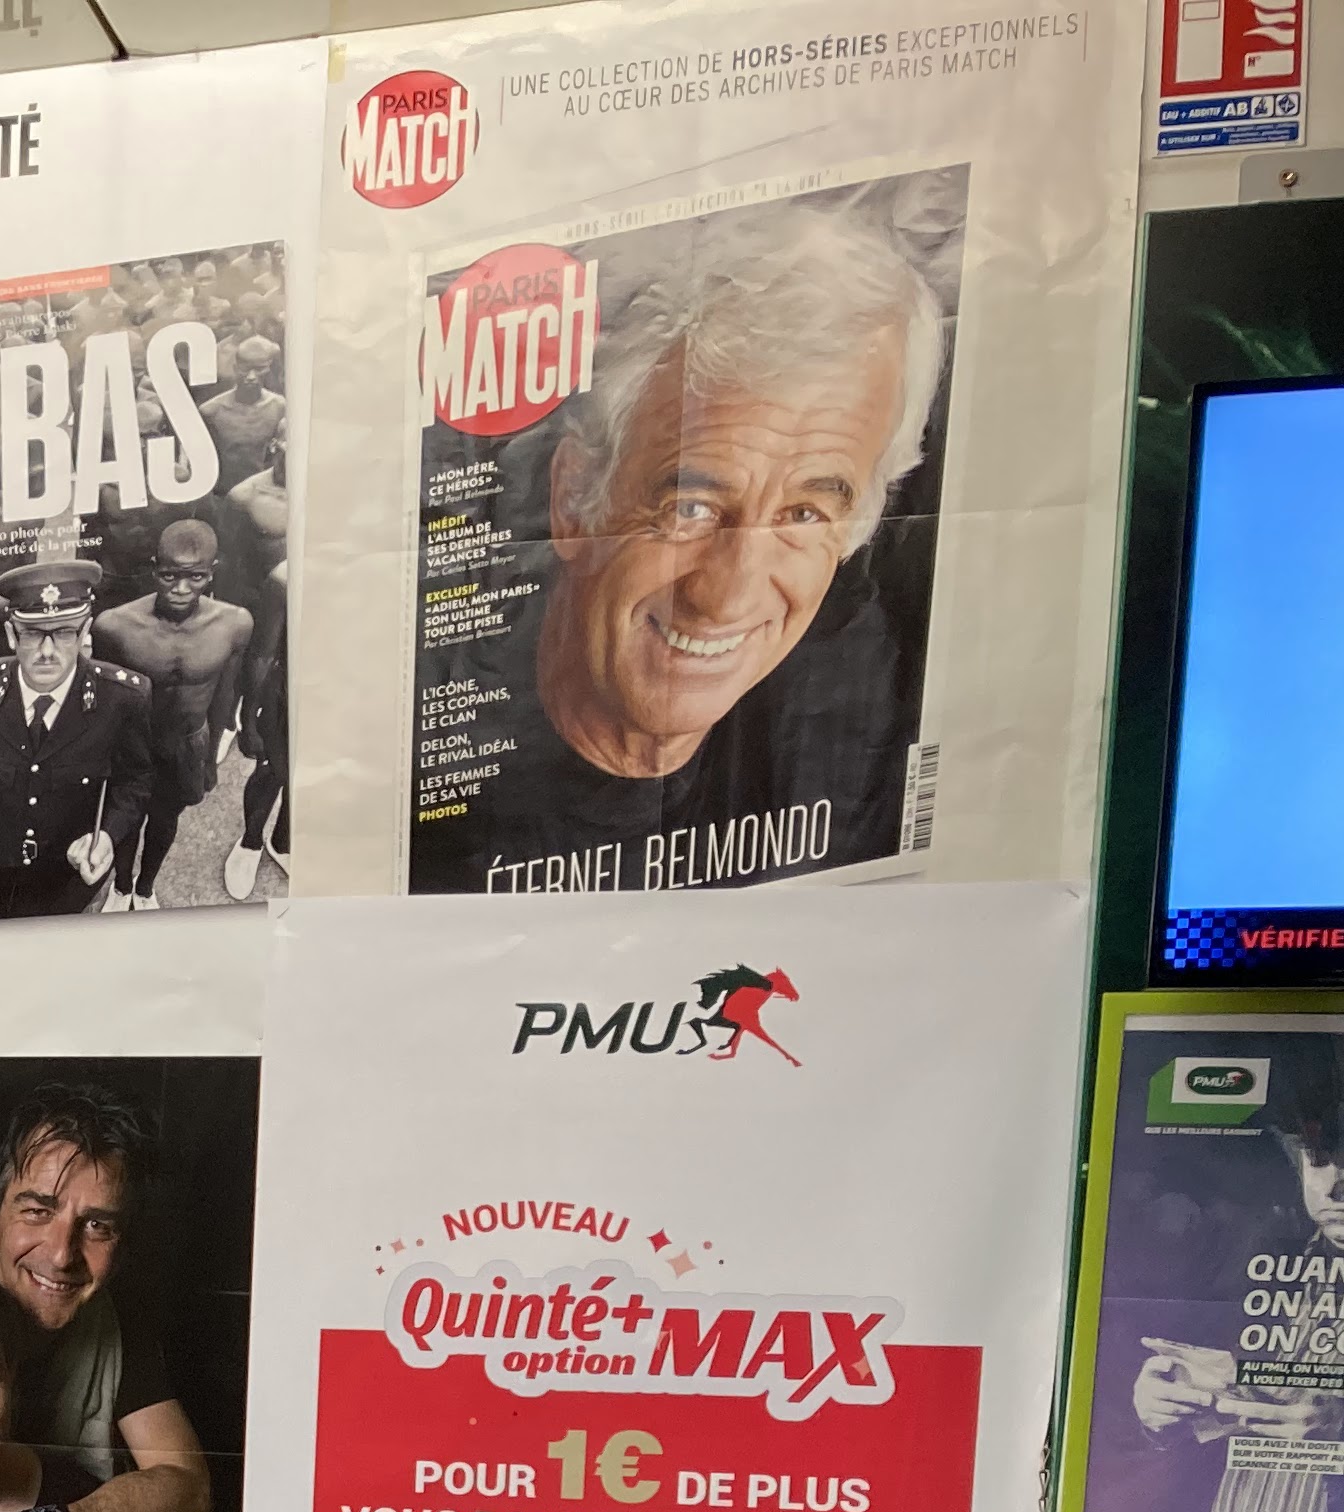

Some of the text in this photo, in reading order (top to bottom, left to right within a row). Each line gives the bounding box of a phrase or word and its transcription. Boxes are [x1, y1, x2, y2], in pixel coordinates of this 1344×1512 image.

[511, 13, 1079, 97] UNE COLLECTION DE HORS-SÉRIES EXCEPTIONNELS
[382, 87, 448, 113] PARIS
[1223, 102, 1249, 117] AB
[343, 86, 476, 191] MATCH
[11, 525, 53, 543] photos
[426, 583, 480, 603] EXCLUSIF
[422, 687, 511, 716] LES COPAINS,
[419, 803, 468, 823] PHOTOS
[645, 799, 832, 892] BELMONDO
[513, 1002, 686, 1054] PMU
[443, 1199, 630, 1243] NOUVEAU
[402, 1275, 654, 1352] Quinté+
[1242, 1289, 1302, 1318] ON
[502, 1308, 885, 1403] option MAX
[1293, 1364, 1310, 1374] ON
[414, 1460, 536, 1500] POUR
[547, 1429, 663, 1504] 1€
[678, 1471, 734, 1508] DE
